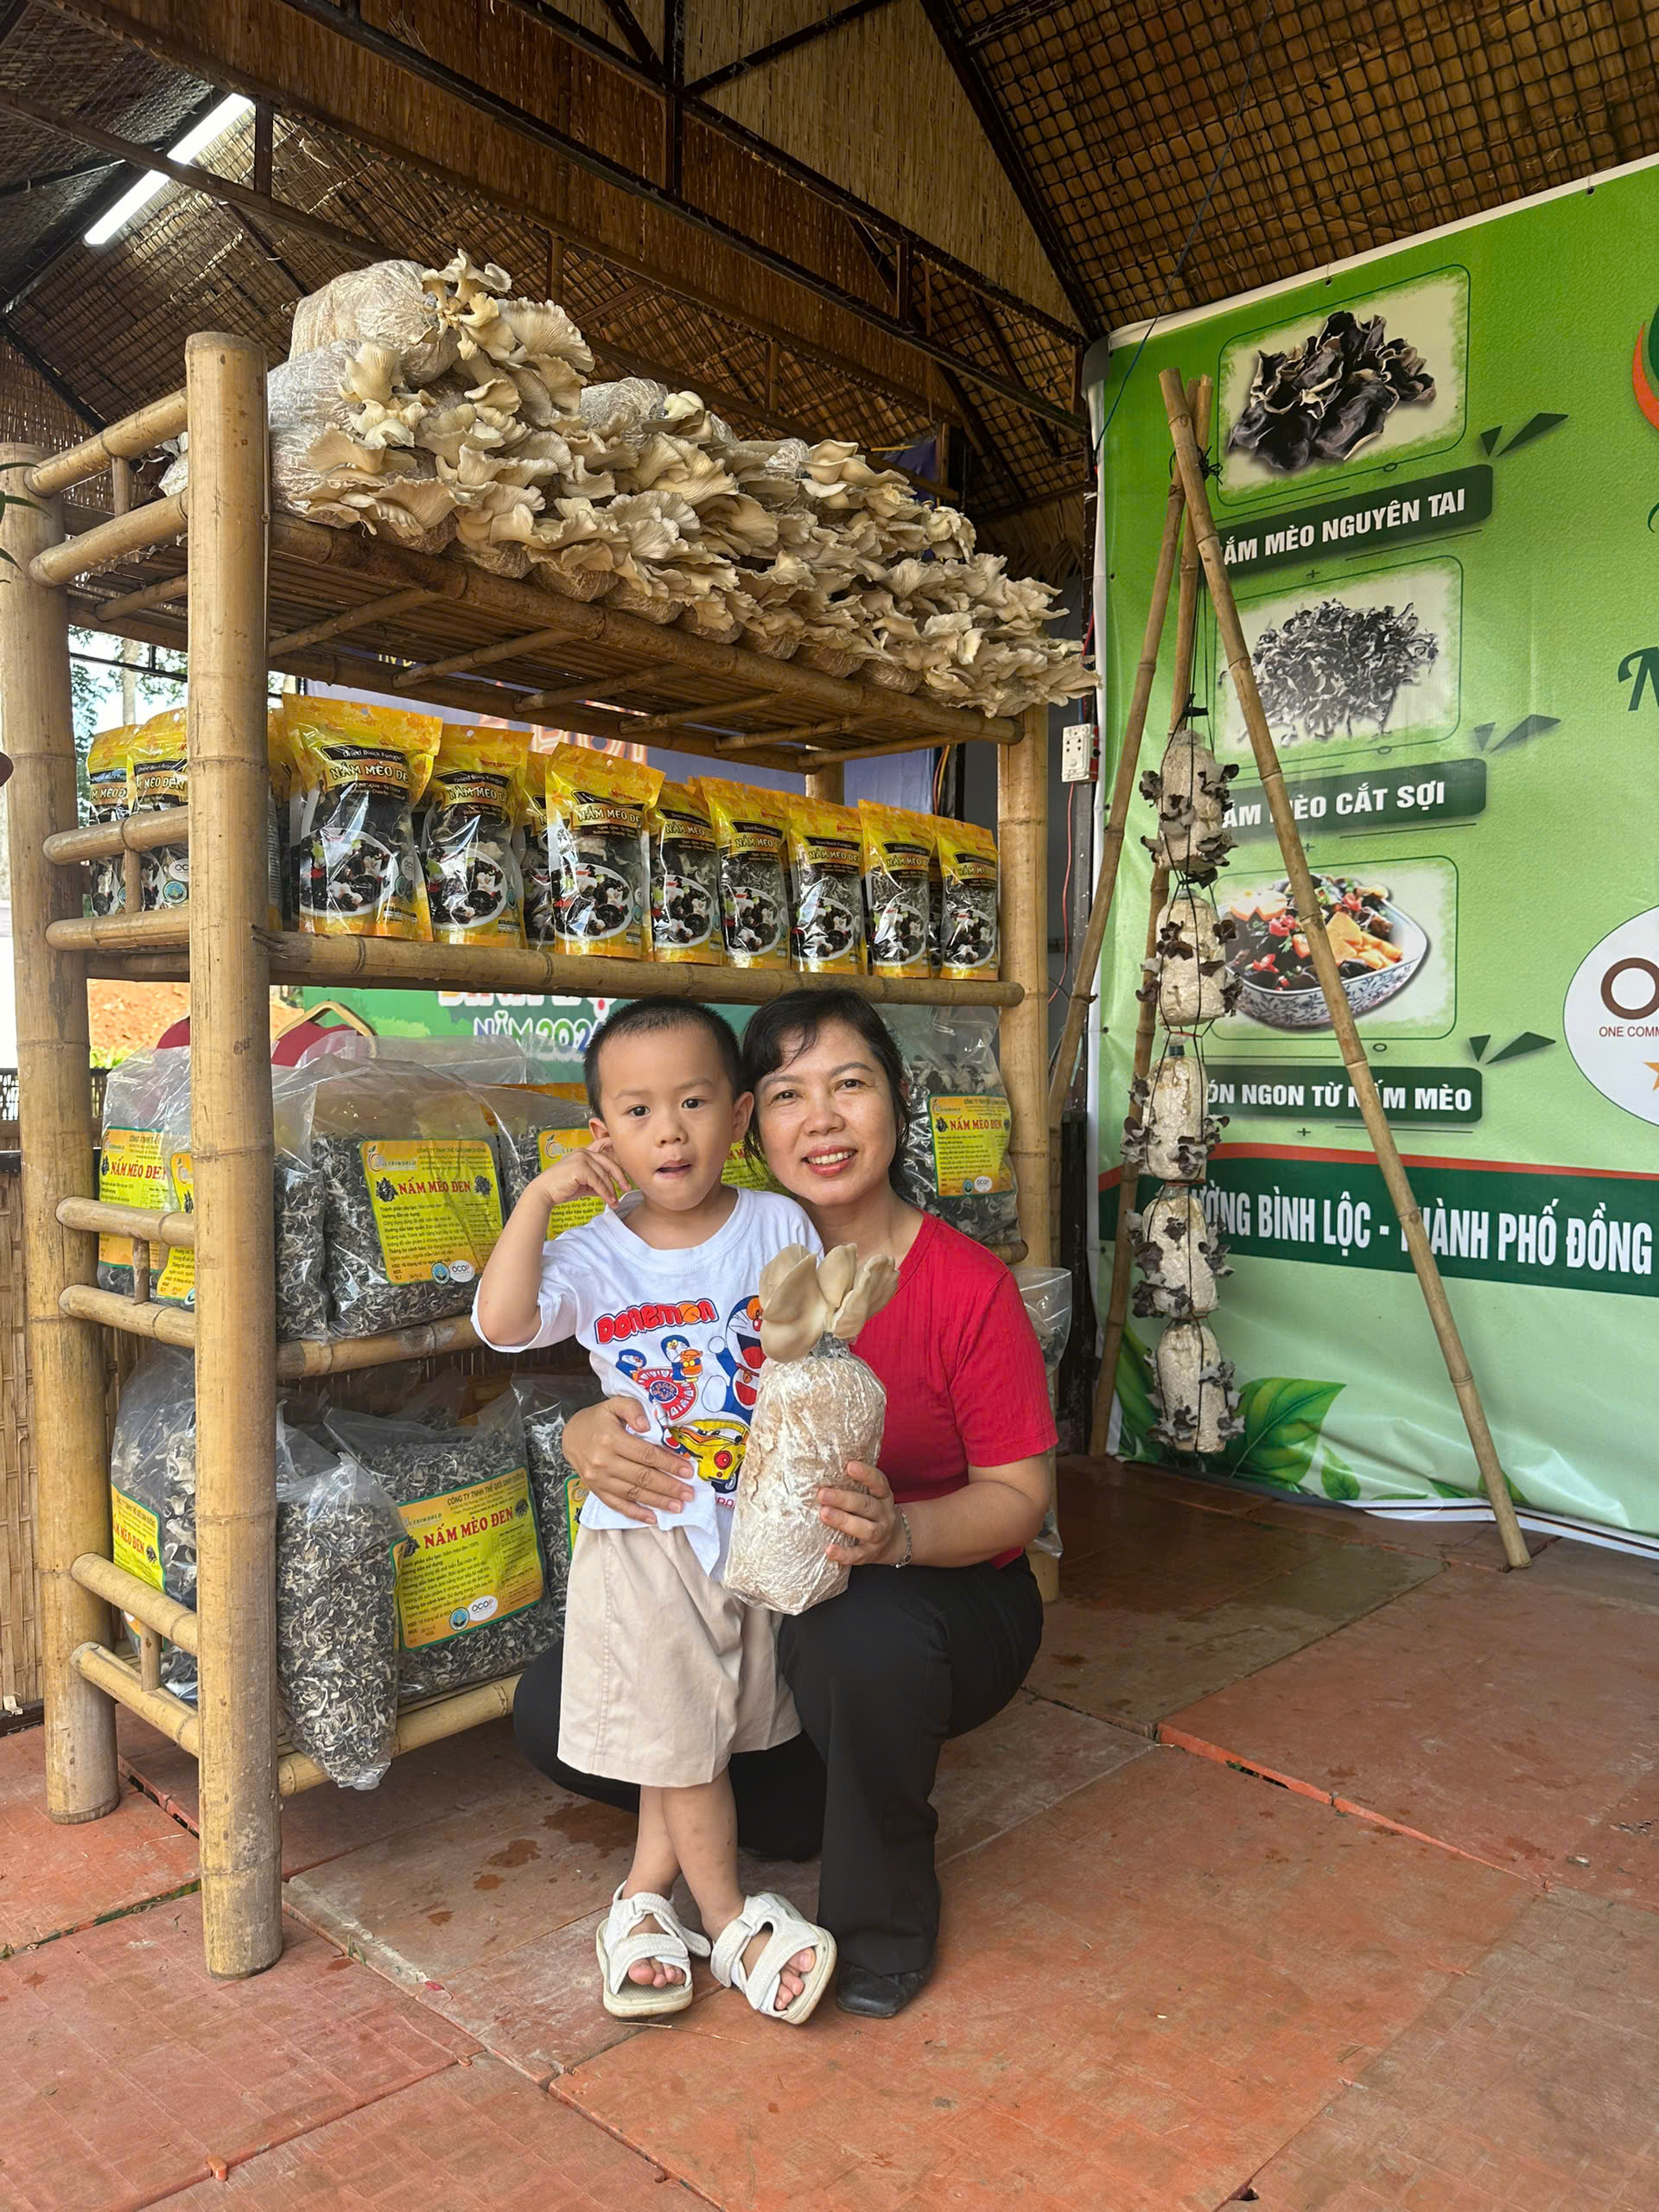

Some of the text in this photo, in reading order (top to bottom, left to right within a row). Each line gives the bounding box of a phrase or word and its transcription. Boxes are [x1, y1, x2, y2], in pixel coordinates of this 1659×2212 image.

[1220, 488, 1465, 565] ẮM MÈO NGUYÊN TAI
[1335, 782, 1388, 815] CẮT
[1396, 780, 1445, 810] SỢI
[1599, 1027, 1624, 1037] ONE
[1206, 1079, 1235, 1103] ÓN
[1242, 1084, 1304, 1106] NGON
[1311, 1082, 1344, 1107] TỪ
[1414, 1083, 1471, 1111] MÈO
[397, 1176, 426, 1195] NẤM
[450, 1180, 471, 1192] ĐEN
[1258, 1185, 1315, 1243] BÌNH
[1323, 1191, 1370, 1256] LỘC
[1379, 1225, 1389, 1236] -
[1401, 1198, 1489, 1260] ÀNH
[1497, 1198, 1559, 1266] PHỐ
[1566, 1202, 1652, 1274] ĐỒNG
[423, 1507, 514, 1548] NẤM MÈO ĐEN
